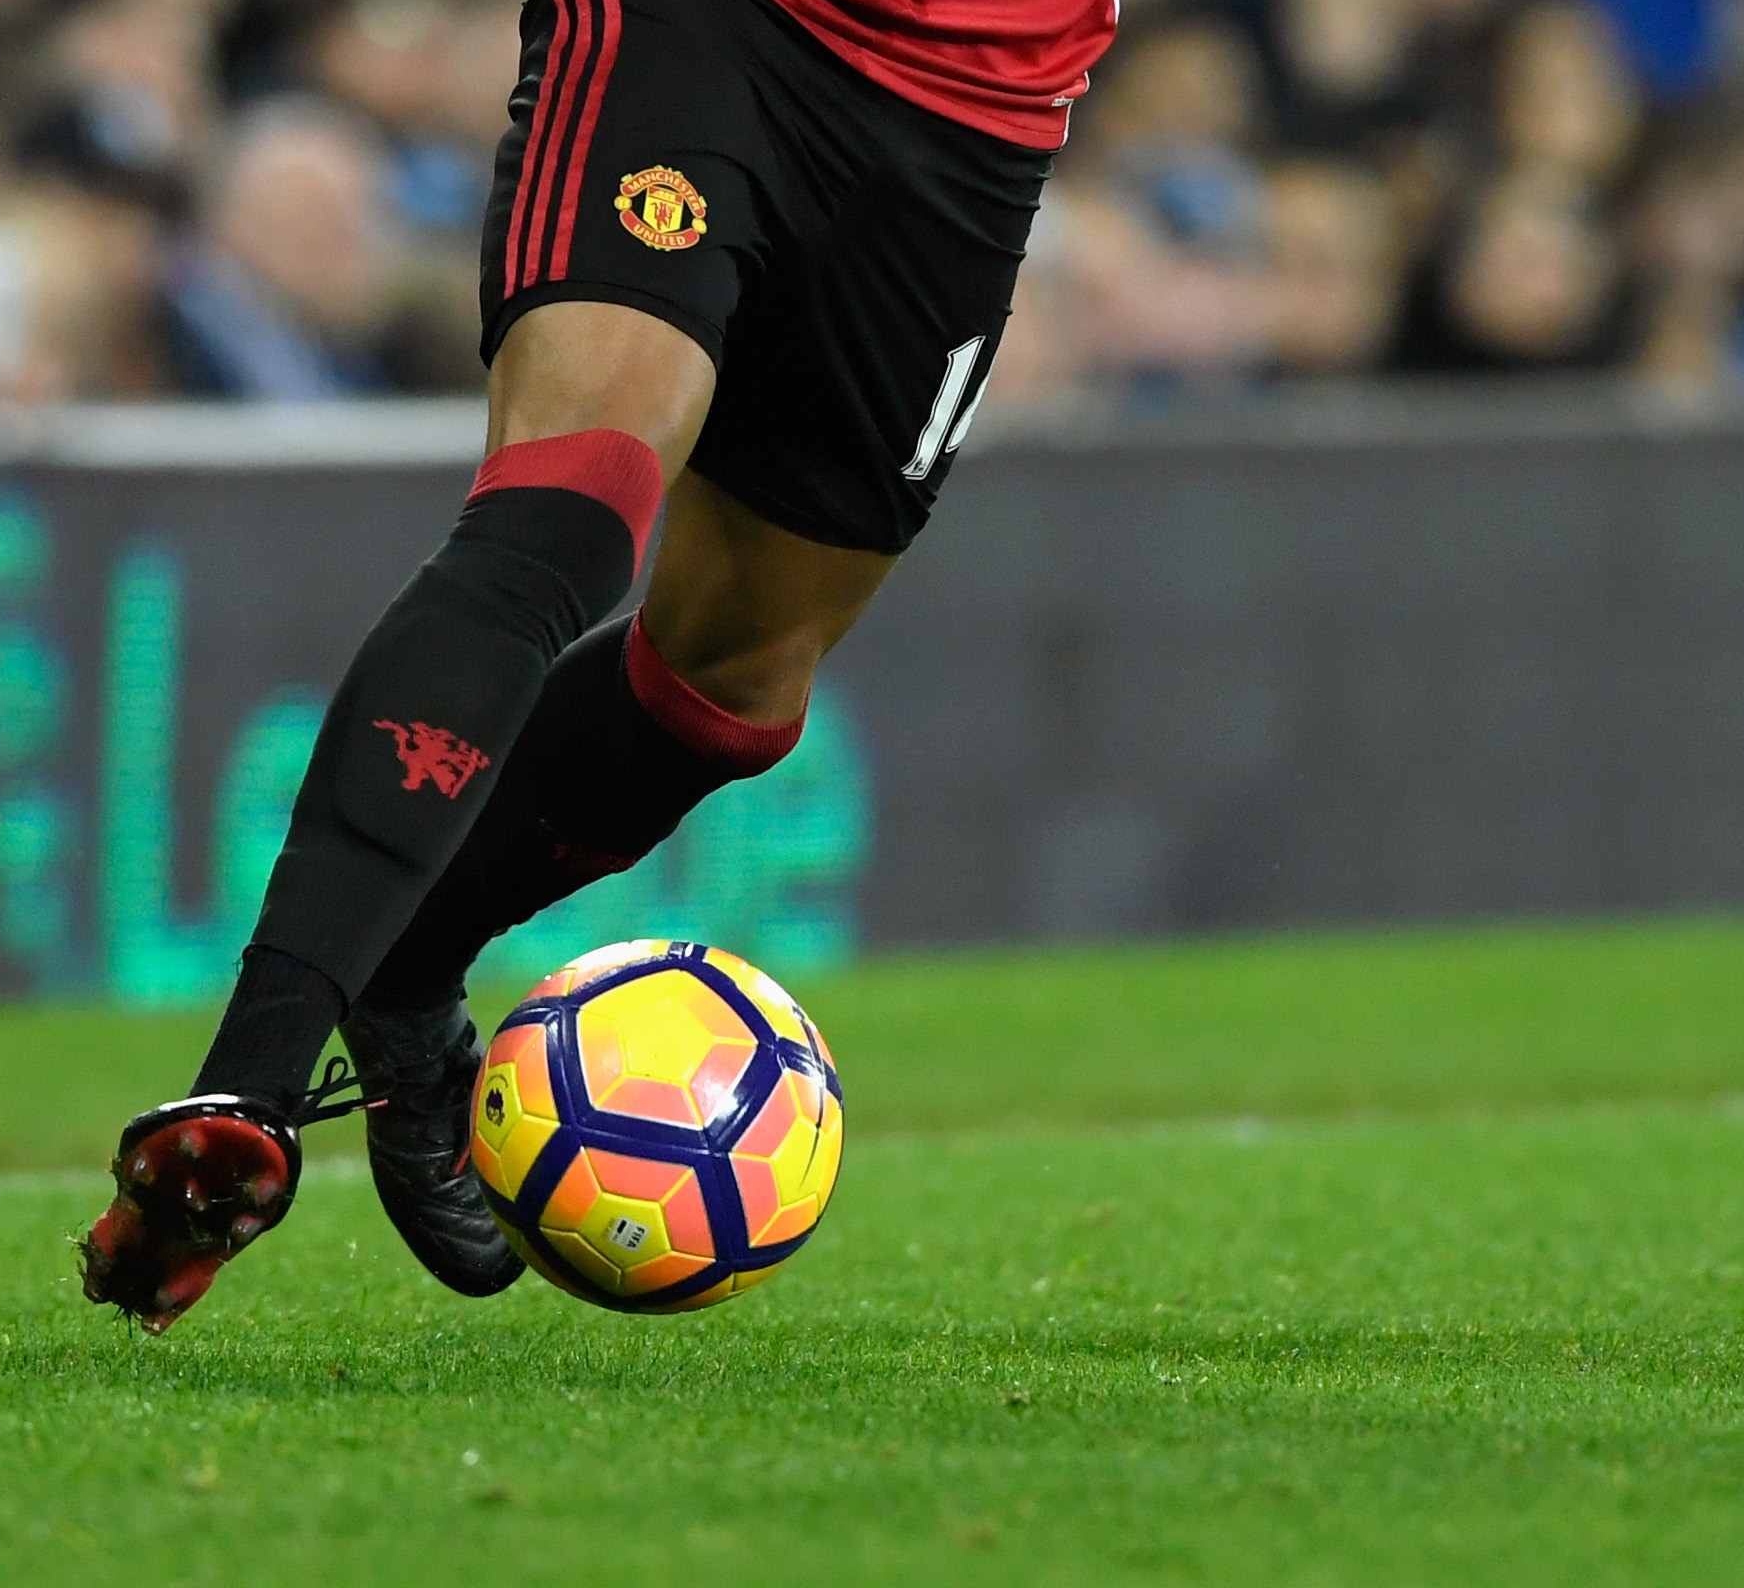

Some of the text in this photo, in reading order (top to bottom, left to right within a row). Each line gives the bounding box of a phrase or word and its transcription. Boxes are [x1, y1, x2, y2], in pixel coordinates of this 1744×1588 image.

[627, 172, 701, 211] MANCHESTER
[633, 223, 686, 246] UNITED
[626, 1225, 646, 1249] FIFA
